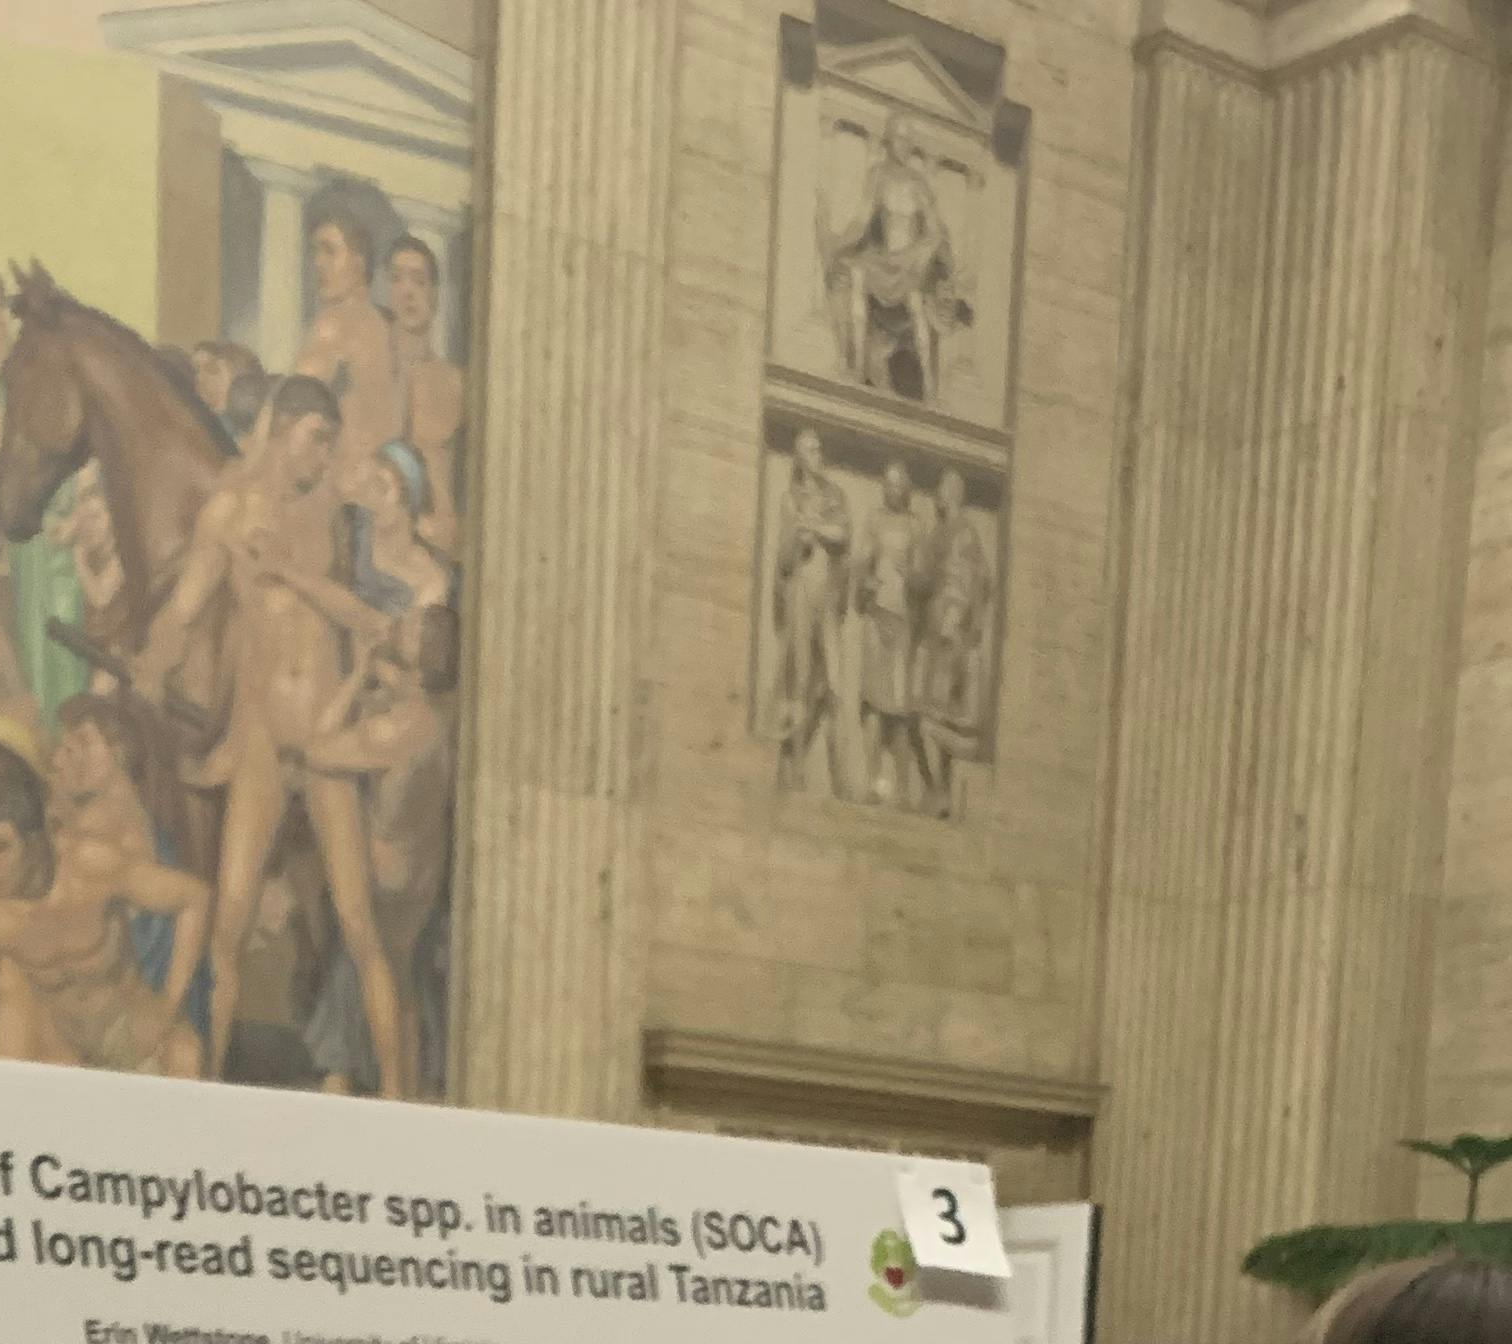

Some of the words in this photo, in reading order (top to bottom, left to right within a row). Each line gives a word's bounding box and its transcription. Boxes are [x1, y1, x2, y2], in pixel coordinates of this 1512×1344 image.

[29, 1154, 372, 1223] Campylobacter
[384, 1195, 473, 1239] spp.
[485, 1194, 522, 1235] in
[534, 1201, 682, 1247] animals
[691, 1210, 822, 1265] (SOCA)
[931, 1187, 966, 1246] 3
[31, 1219, 255, 1283] long-read
[267, 1247, 512, 1304] sequencing
[523, 1254, 560, 1295] in
[571, 1263, 659, 1301] rural
[667, 1263, 827, 1311] Tanzania
